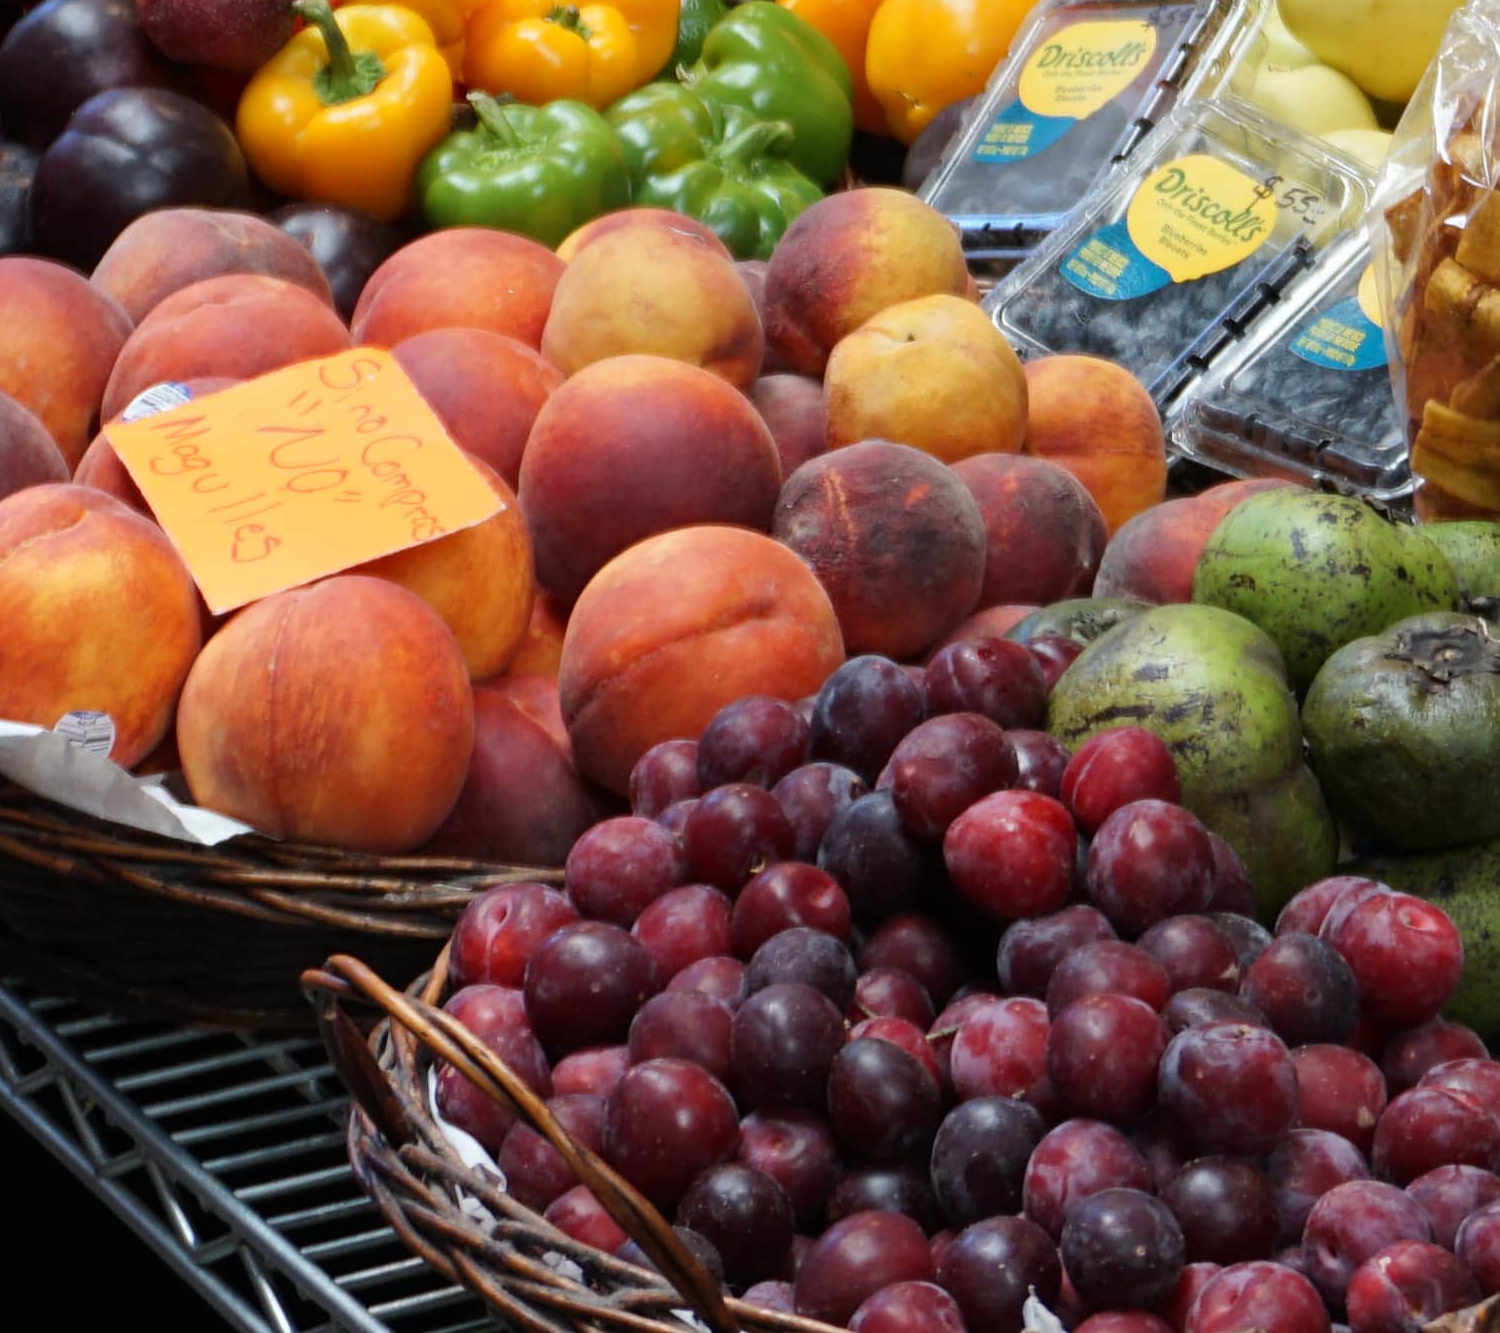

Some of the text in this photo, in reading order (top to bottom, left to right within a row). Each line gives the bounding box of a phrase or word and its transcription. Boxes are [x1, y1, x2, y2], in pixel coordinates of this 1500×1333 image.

[1037, 42, 1147, 70] Driscoll's
[1153, 166, 1266, 243] Driscoll's
[1160, 221, 1210, 257] Blueberries
